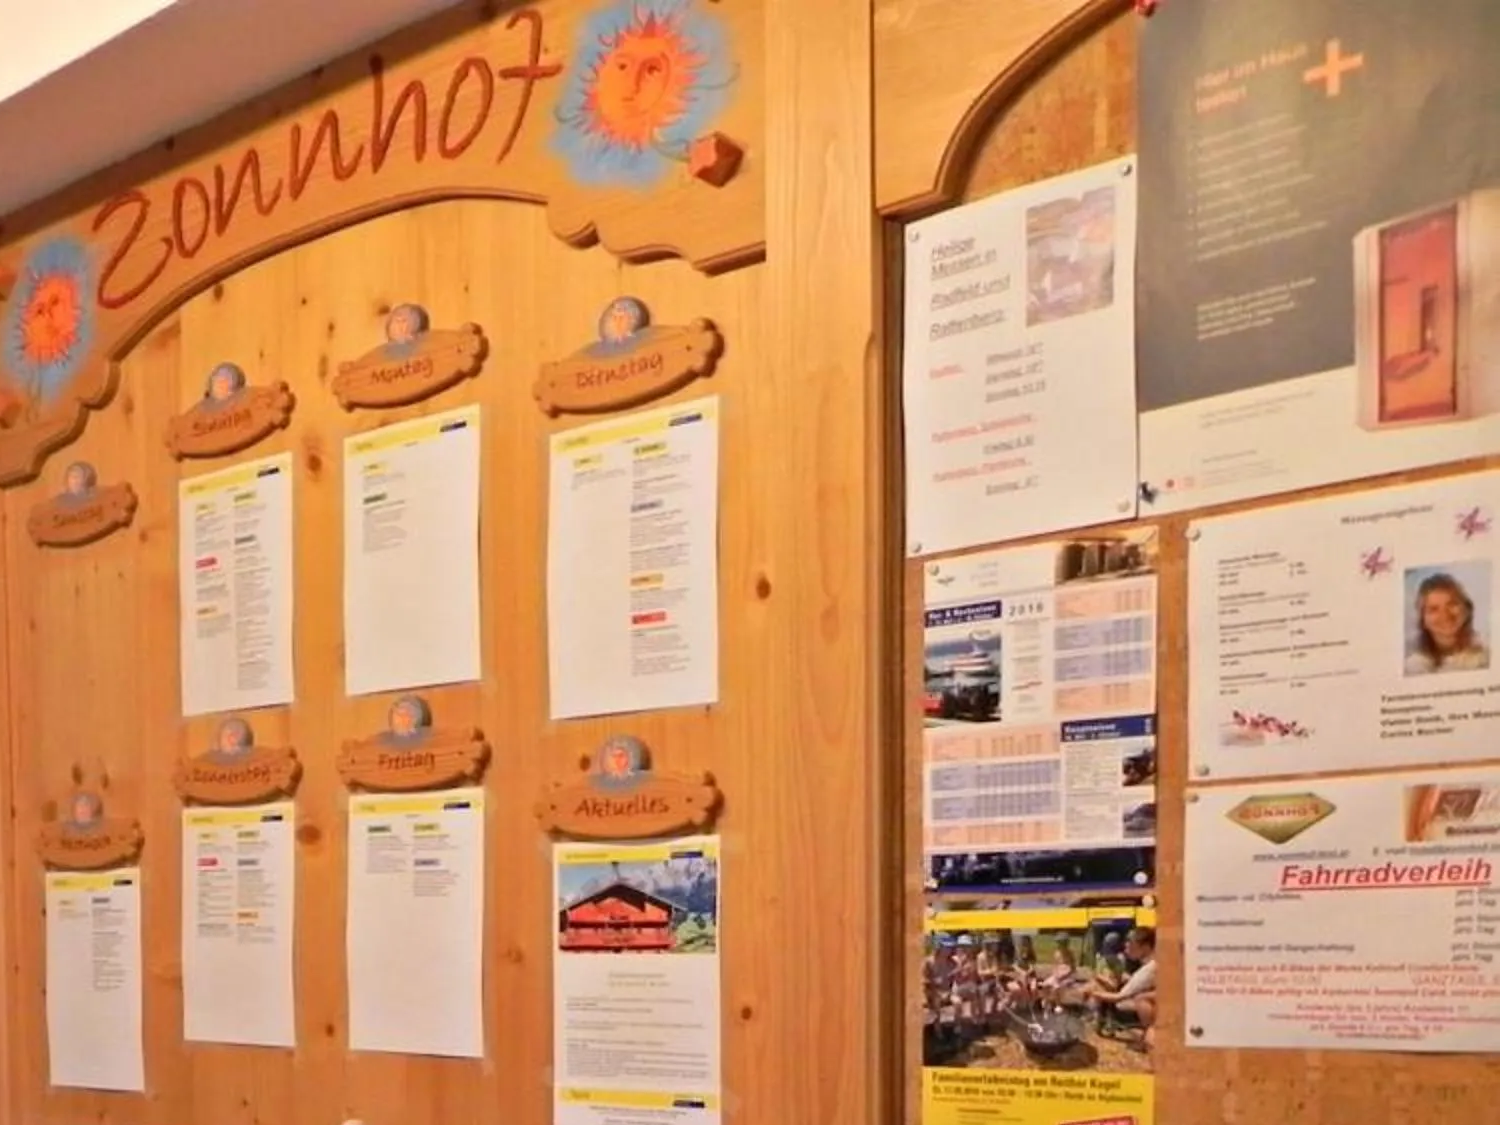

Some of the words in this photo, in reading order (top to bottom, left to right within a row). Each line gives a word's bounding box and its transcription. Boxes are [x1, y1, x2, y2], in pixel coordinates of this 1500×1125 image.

[92, 9, 562, 309] Sonnhof
[370, 353, 434, 384] Montag
[575, 352, 664, 389] Dienstag
[378, 751, 436, 771] Freitag
[574, 796, 670, 819] Aktuelles
[1281, 857, 1492, 888] Fahrradverleih
